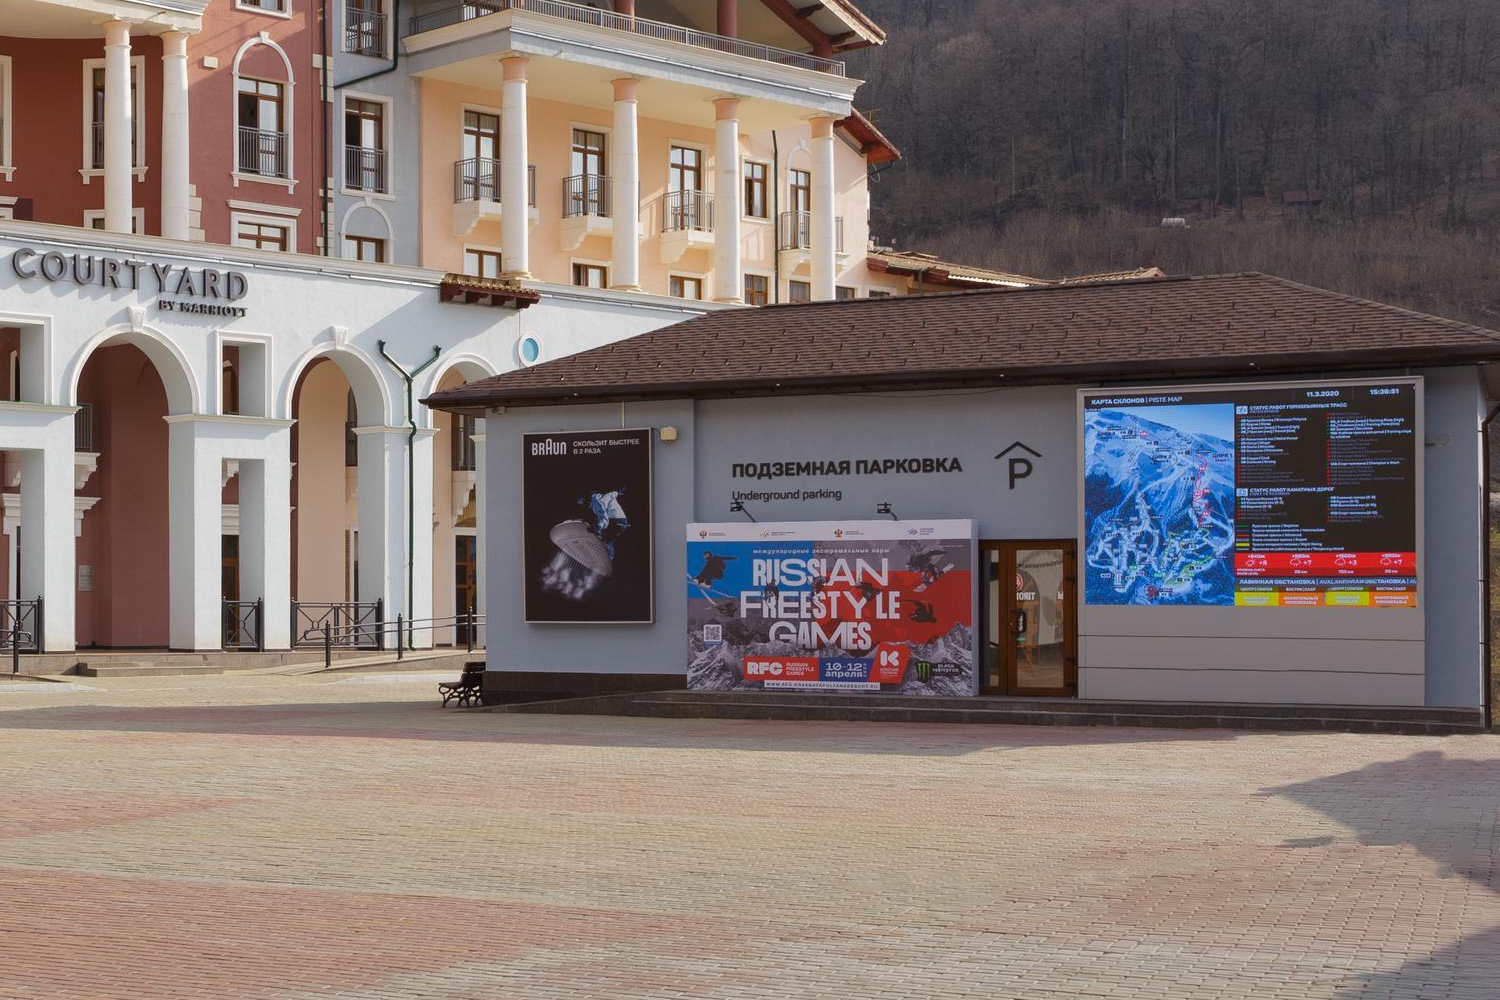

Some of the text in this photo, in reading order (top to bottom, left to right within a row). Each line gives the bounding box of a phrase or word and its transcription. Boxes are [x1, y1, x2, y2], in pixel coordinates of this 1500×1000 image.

[12, 247, 249, 301] COURTYARD
[158, 300, 248, 318] BY MARRIOTT
[1306, 390, 1340, 398] 11.3.2020
[608, 438, 640, 446] БЫСТРЕЕ
[731, 457, 963, 480] ПОДЗЕМНАЯ ПАРКОВКА
[731, 488, 843, 503] Underground parking
[752, 557, 889, 587] RUSSIAN
[740, 590, 900, 619] FREESTYLE
[769, 621, 872, 650] GAMES
[825, 671, 863, 679] апреля
